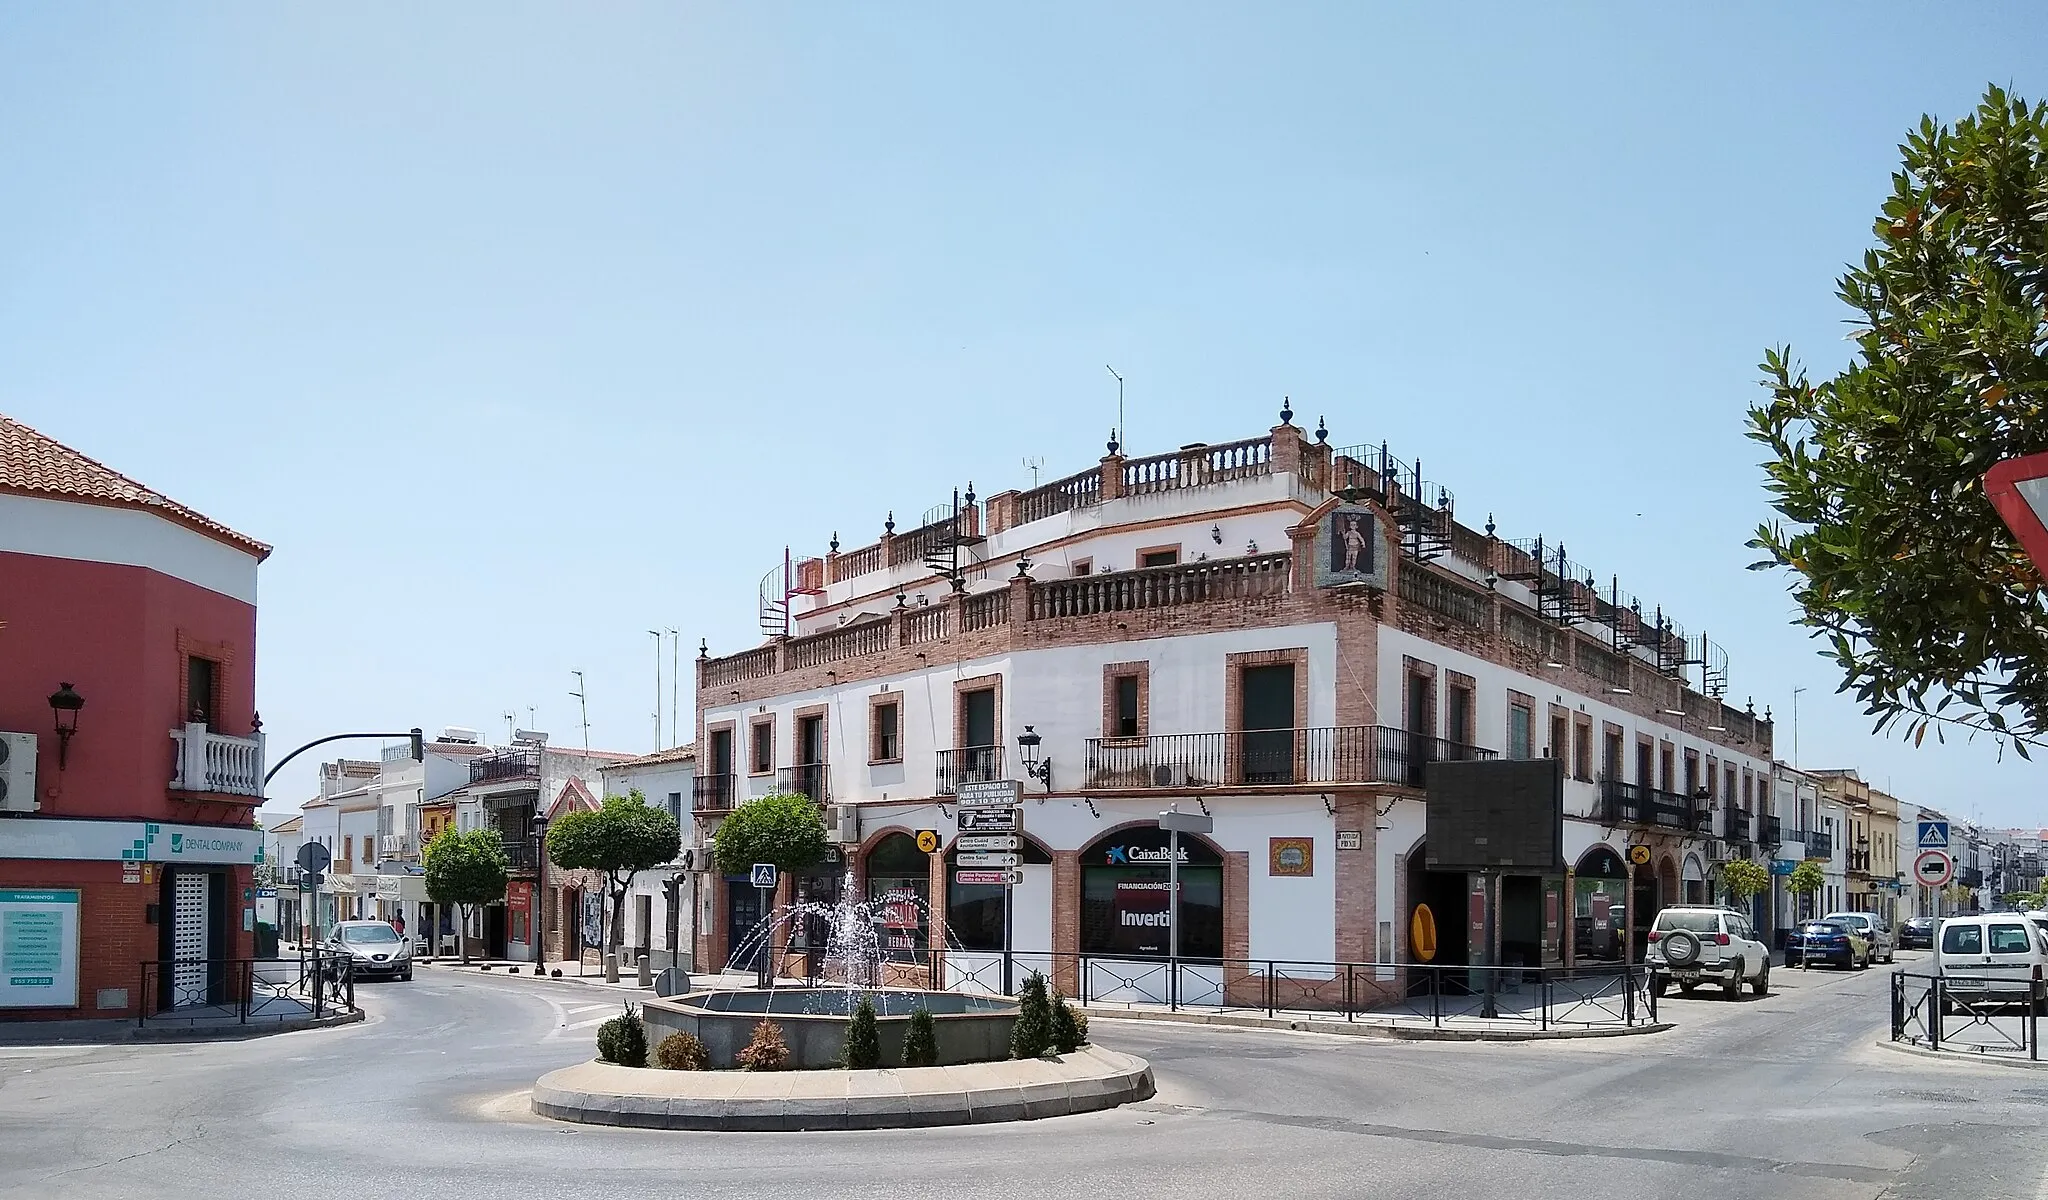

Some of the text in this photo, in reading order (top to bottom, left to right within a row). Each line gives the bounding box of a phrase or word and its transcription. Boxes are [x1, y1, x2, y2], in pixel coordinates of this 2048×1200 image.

[979, 783, 1001, 791] ESPACIO
[983, 790, 1015, 798] PUBLICIDAD
[186, 838, 243, 852] DENTAL COMPANY
[1128, 846, 1189, 860] CaixaBank
[1117, 881, 1163, 890] FINANCIACIÓN
[885, 904, 918, 923] REBAJAS
[888, 936, 915, 948] REBAJAS
